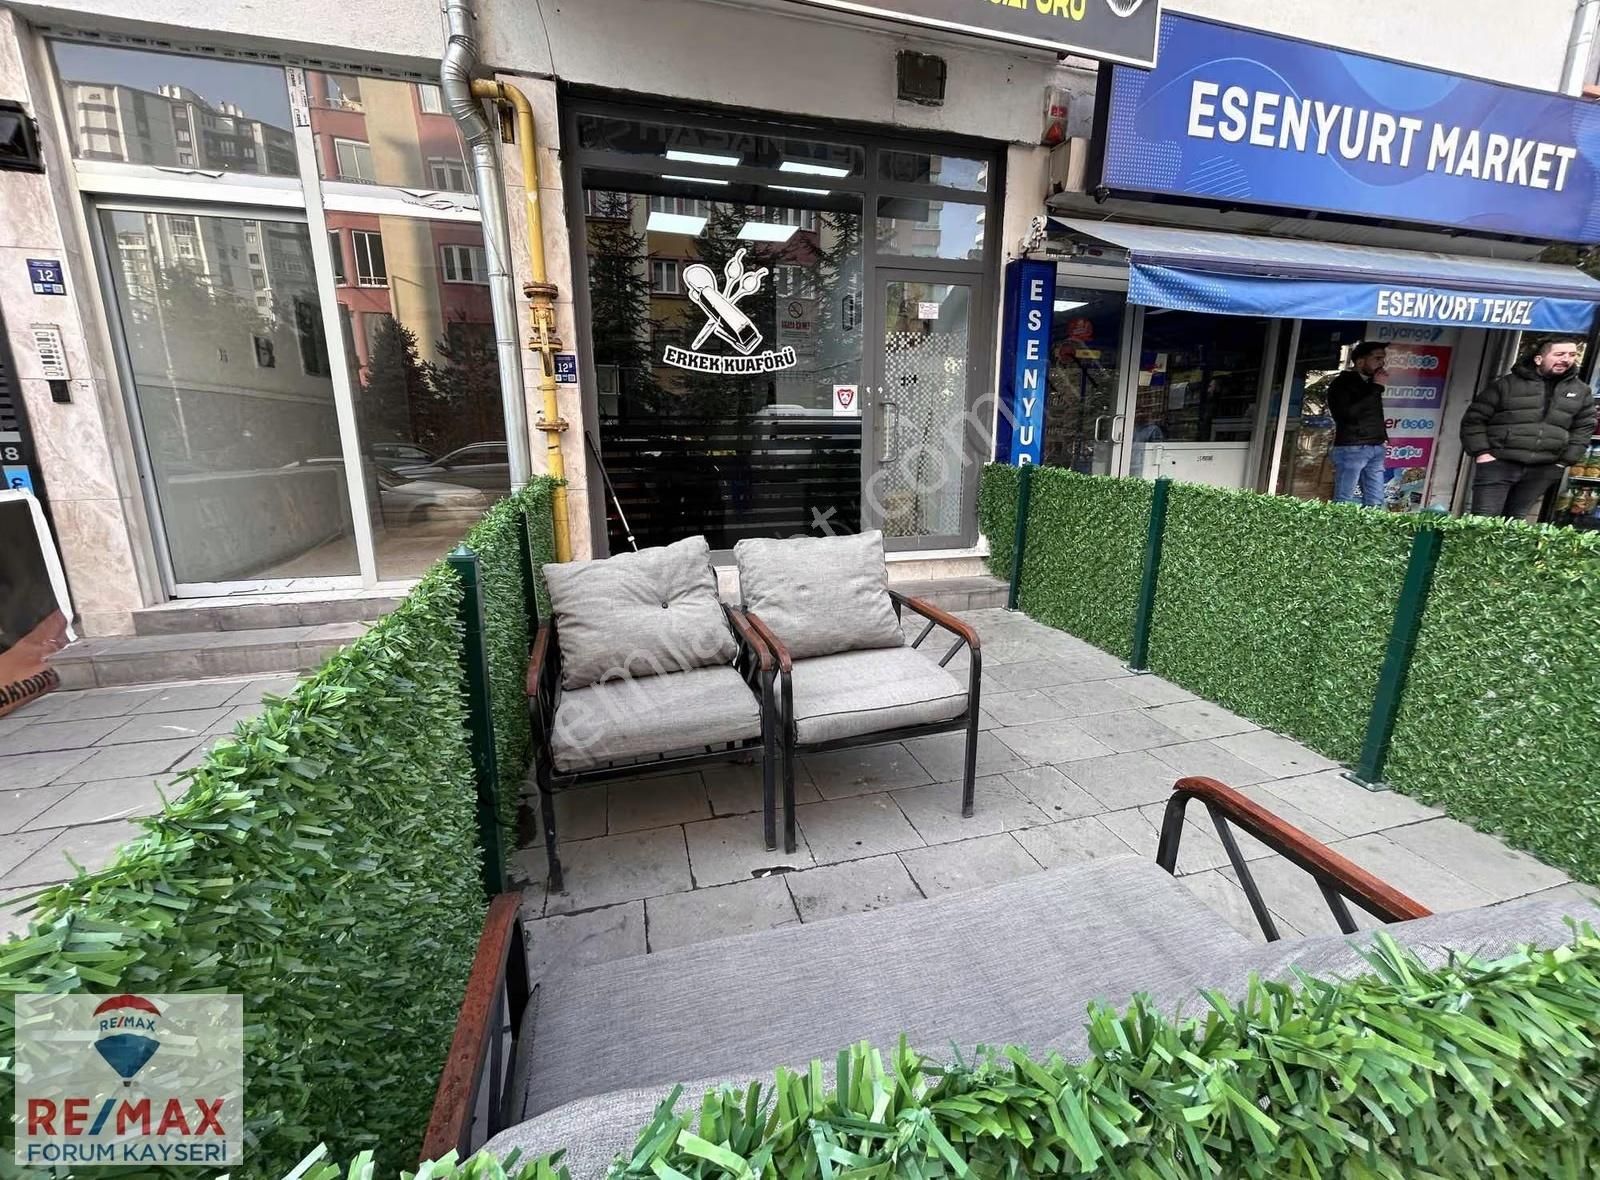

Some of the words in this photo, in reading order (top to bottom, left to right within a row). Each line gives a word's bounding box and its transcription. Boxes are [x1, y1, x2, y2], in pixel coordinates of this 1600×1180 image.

[1187, 80, 1422, 168] ESENYURT
[1426, 123, 1577, 192] MARKET
[37, 269, 55, 281] 12
[1376, 291, 1479, 322] ESENYURT
[1481, 298, 1534, 325] TEKEL
[665, 348, 720, 371] ERKEK
[724, 347, 795, 372] KUAFÖRÜ
[1386, 387, 1434, 399] numara
